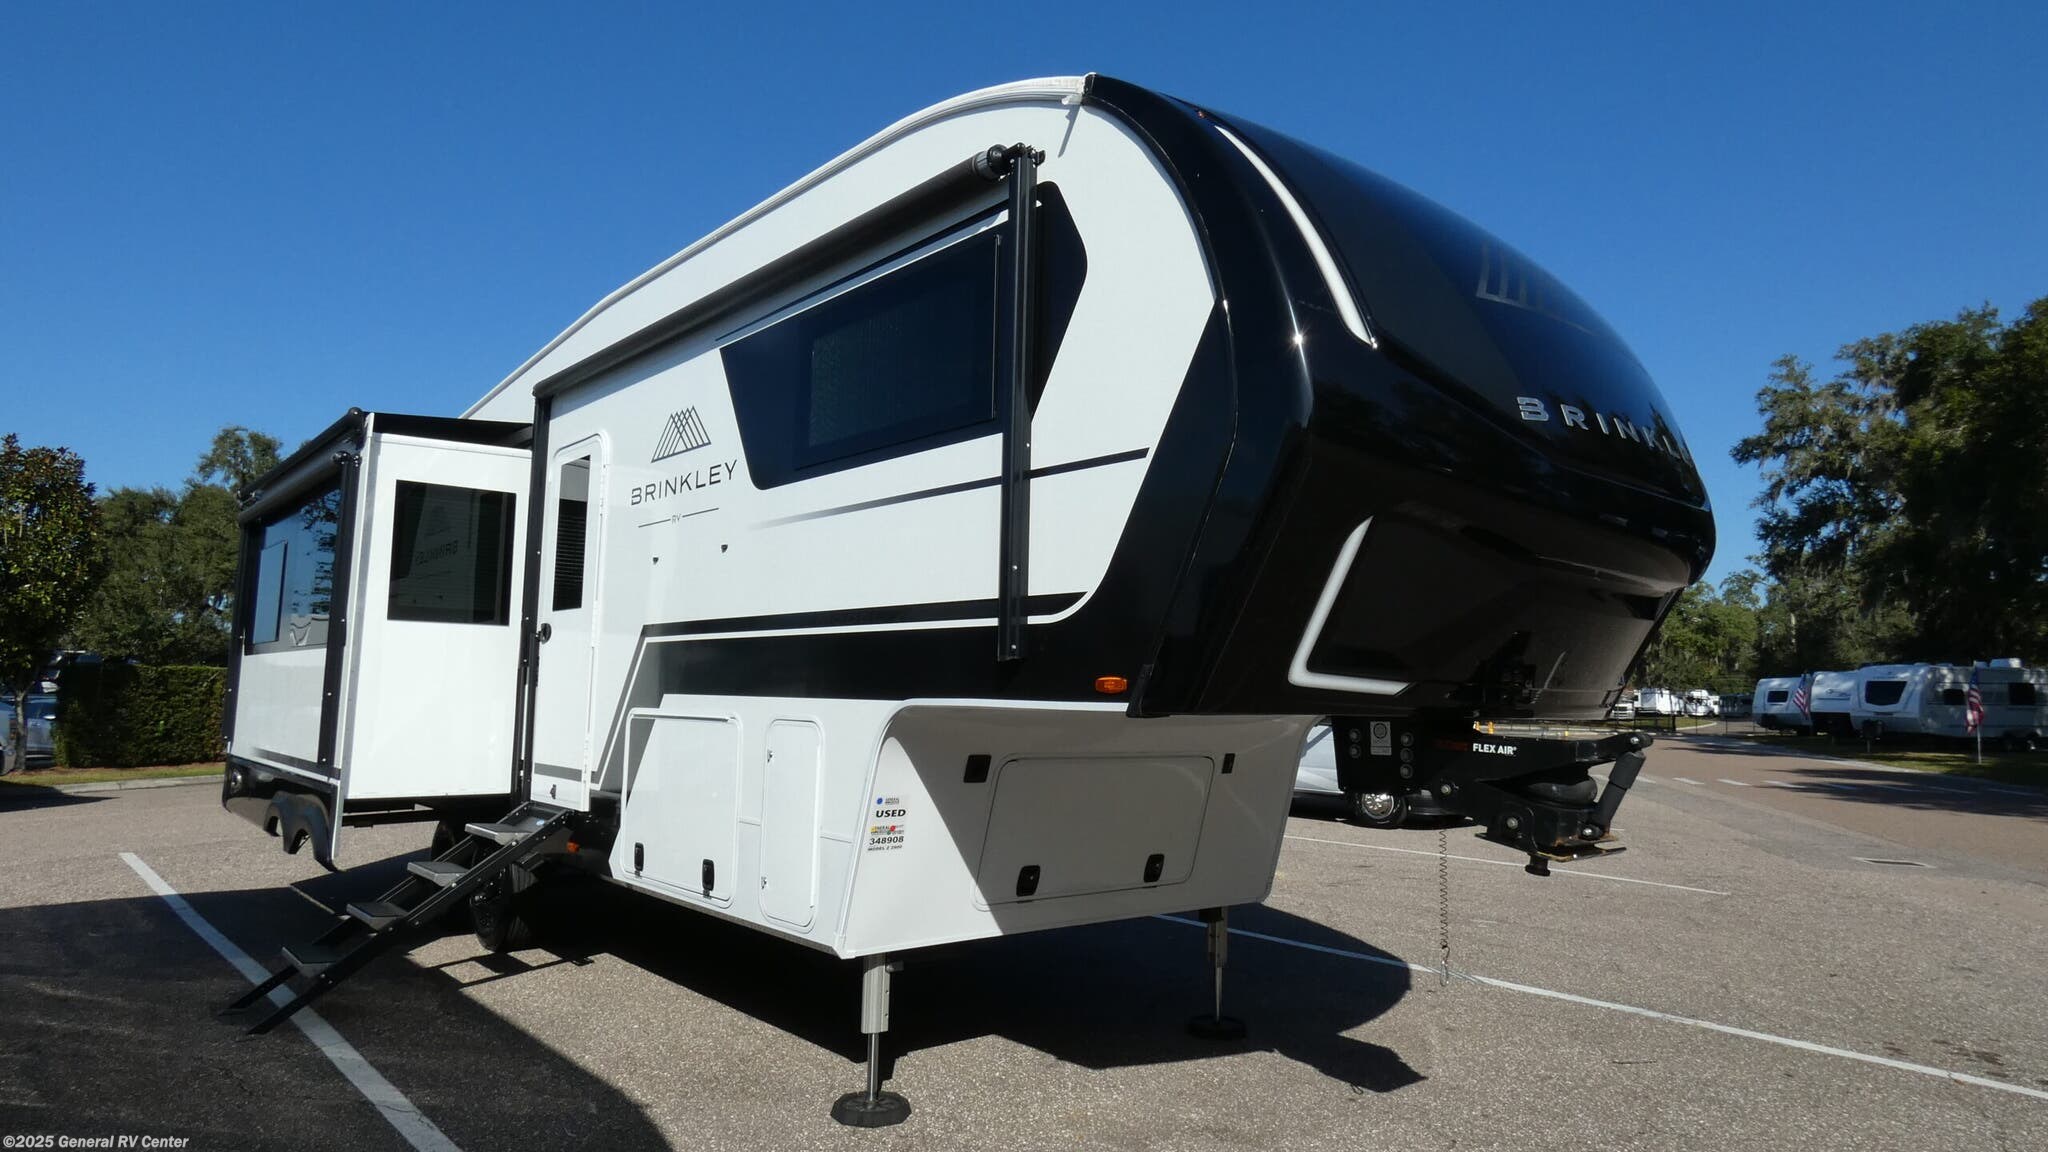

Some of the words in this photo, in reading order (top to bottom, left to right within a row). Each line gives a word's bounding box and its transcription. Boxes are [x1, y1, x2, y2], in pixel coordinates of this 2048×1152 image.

[631, 459, 737, 506] BRINKLEY
[671, 513, 682, 524] RV
[1472, 743, 1497, 754] FLEX
[875, 809, 906, 818] USED
[869, 836, 904, 846] 348908
